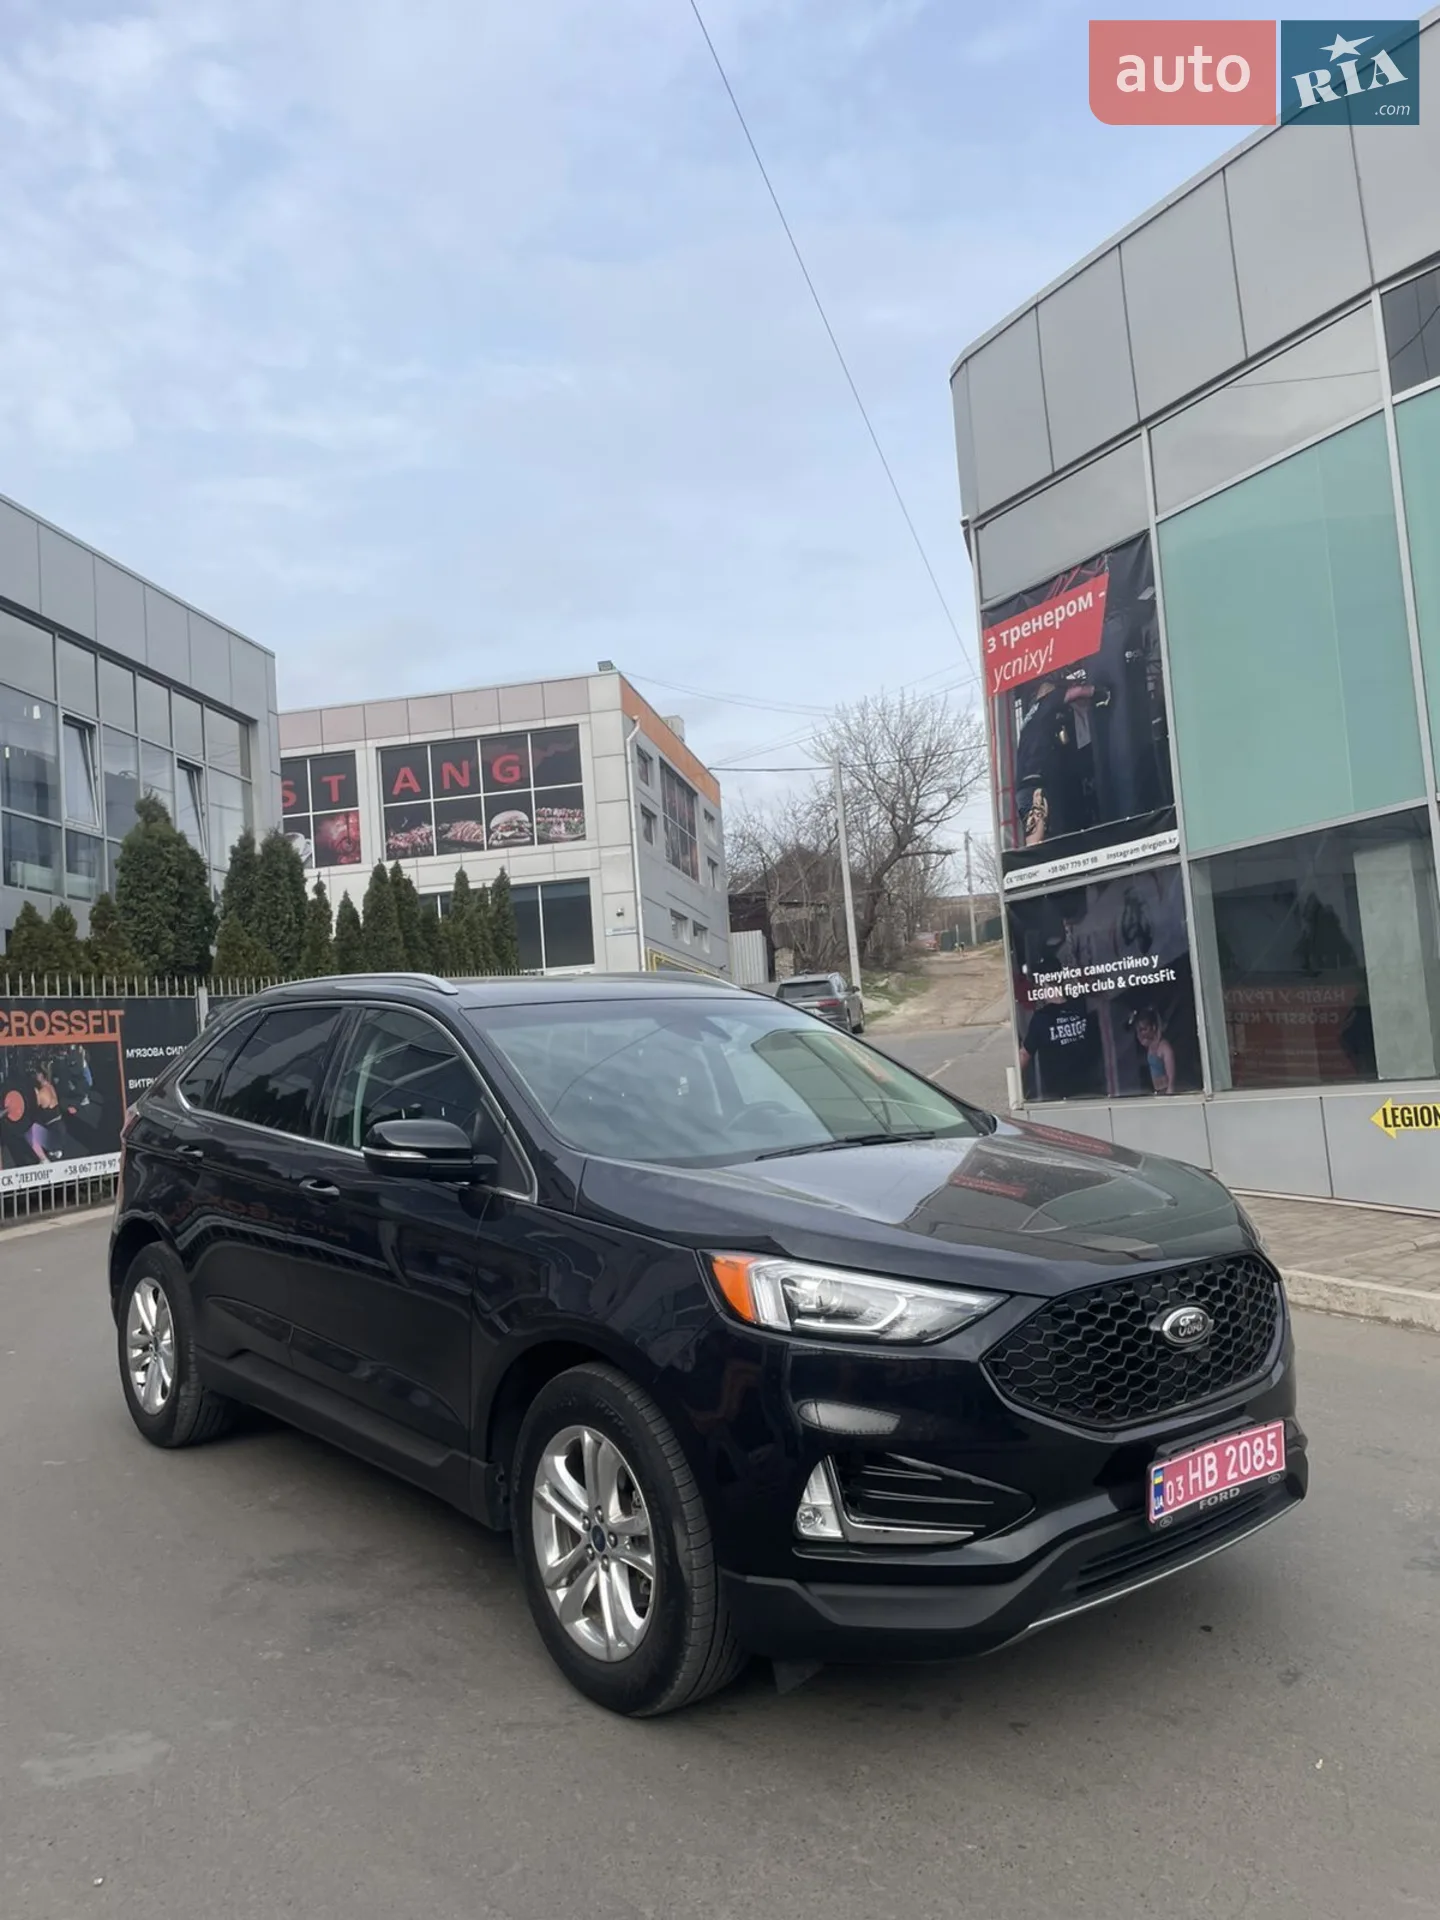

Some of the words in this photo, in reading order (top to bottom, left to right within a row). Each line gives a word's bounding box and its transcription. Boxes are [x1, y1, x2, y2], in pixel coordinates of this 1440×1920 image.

[987, 636, 996, 654] з
[1000, 592, 1094, 648] тренером
[993, 638, 1055, 693] успіху!
[1106, 846, 1140, 860] Instagram
[1033, 966, 1082, 986] Тренуйся
[1083, 956, 1150, 977] самостійно
[1151, 955, 1159, 969] у
[1027, 986, 1063, 1002] LEGION
[1064, 982, 1090, 998] fight
[1091, 977, 1116, 993] club
[1117, 976, 1127, 989] &
[1128, 968, 1177, 986] CrossFit
[0, 1009, 124, 1037] CROSSFIT
[126, 1047, 165, 1058] М'ЯЗОВА
[1382, 1105, 1440, 1128] LEGION
[64, 1165, 78, 1175] +38
[79, 1162, 92, 1173] 067
[1, 1175, 13, 1187] СК
[1166, 1475, 1184, 1505] 03
[1225, 1432, 1277, 1481] 2085
[1154, 1496, 1164, 1510] UA
[1199, 1487, 1240, 1510] FORD
